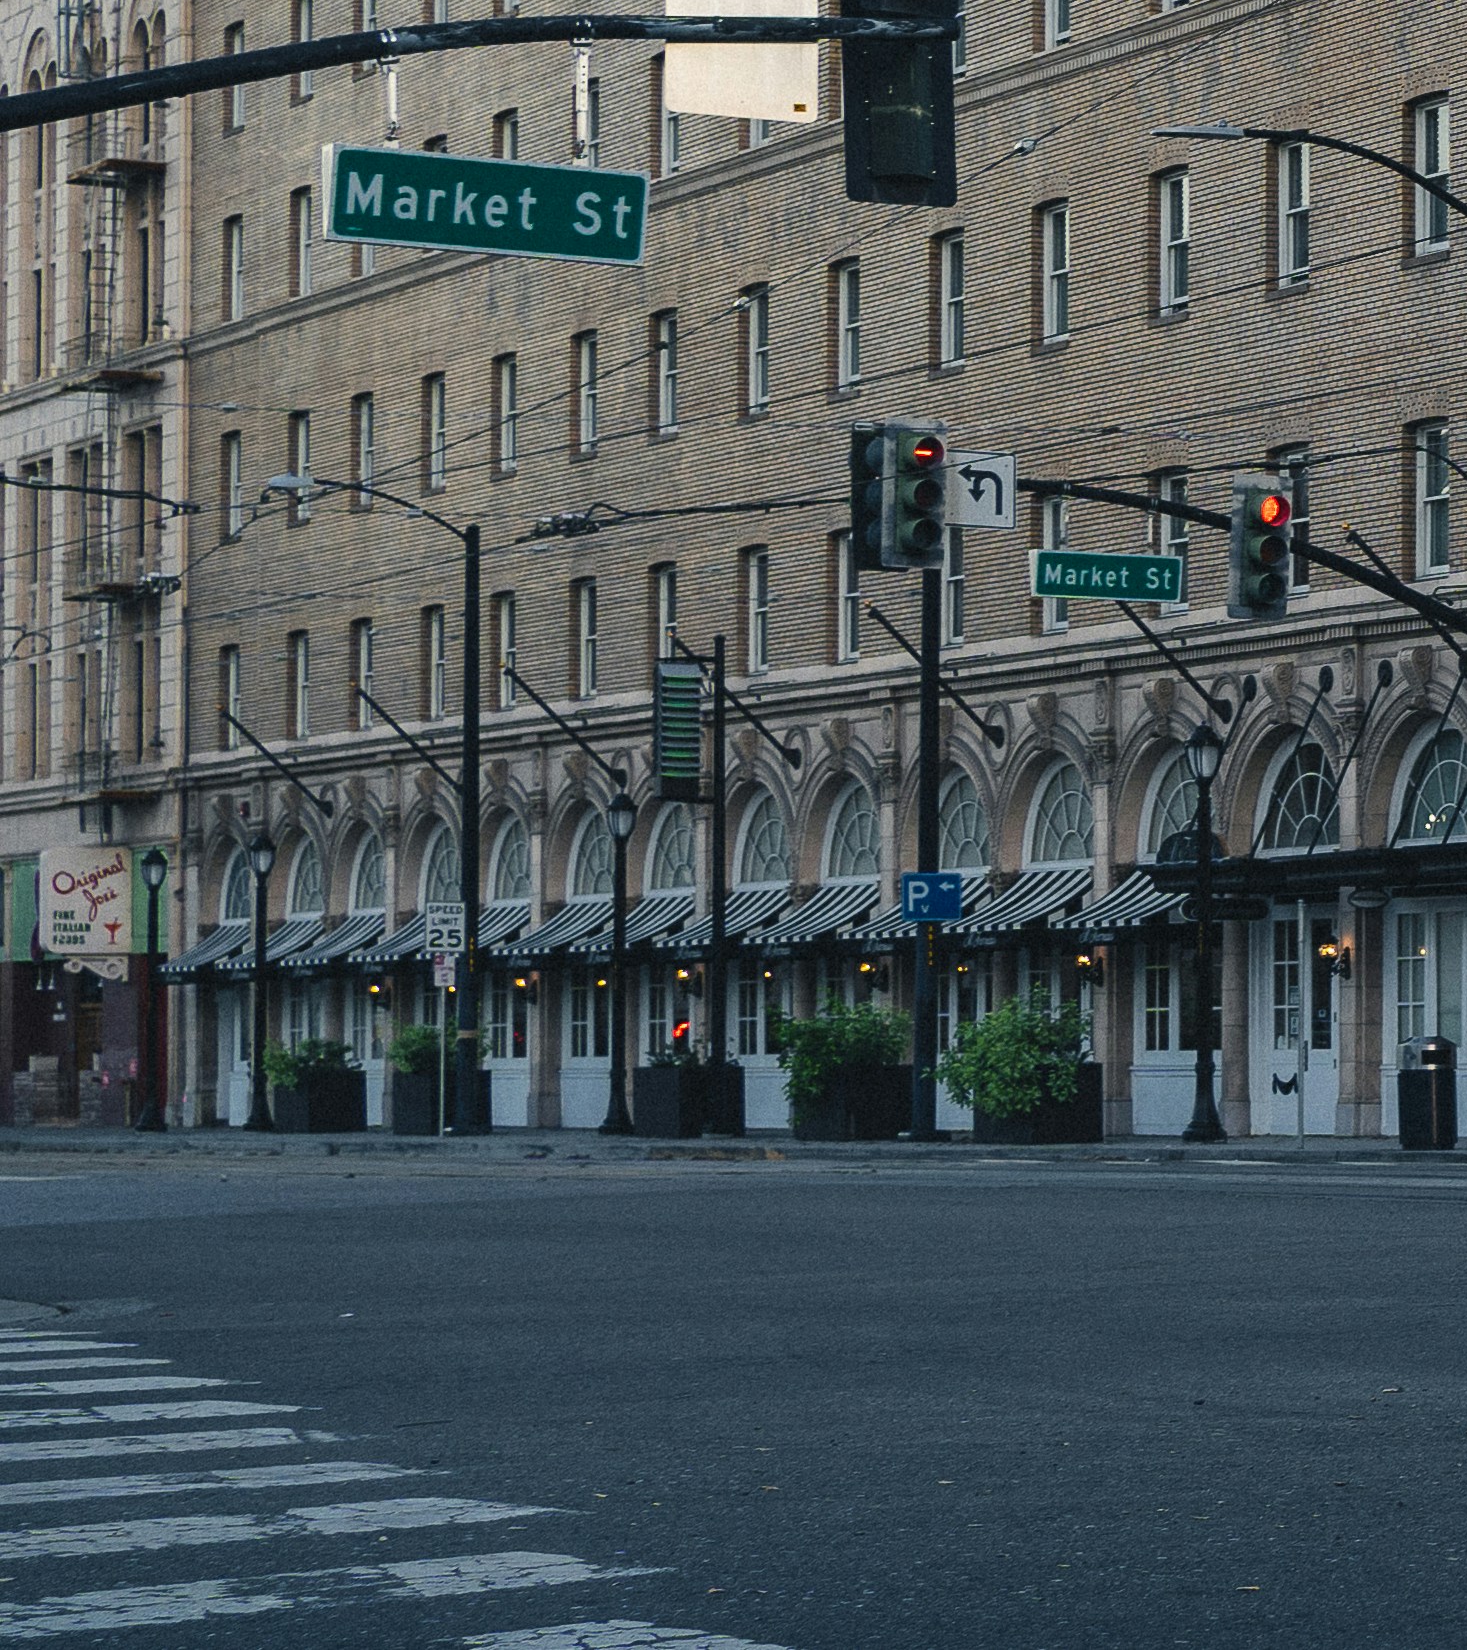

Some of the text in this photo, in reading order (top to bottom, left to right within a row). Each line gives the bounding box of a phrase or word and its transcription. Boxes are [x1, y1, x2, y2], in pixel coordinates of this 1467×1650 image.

[345, 171, 632, 239] Market St
[1044, 563, 1172, 590] Market St
[52, 853, 127, 895] Original
[908, 881, 929, 912] P
[429, 905, 463, 914] SPEED
[53, 923, 91, 932] ITALIAN
[432, 917, 459, 926] LIMIT
[429, 929, 462, 948] 25
